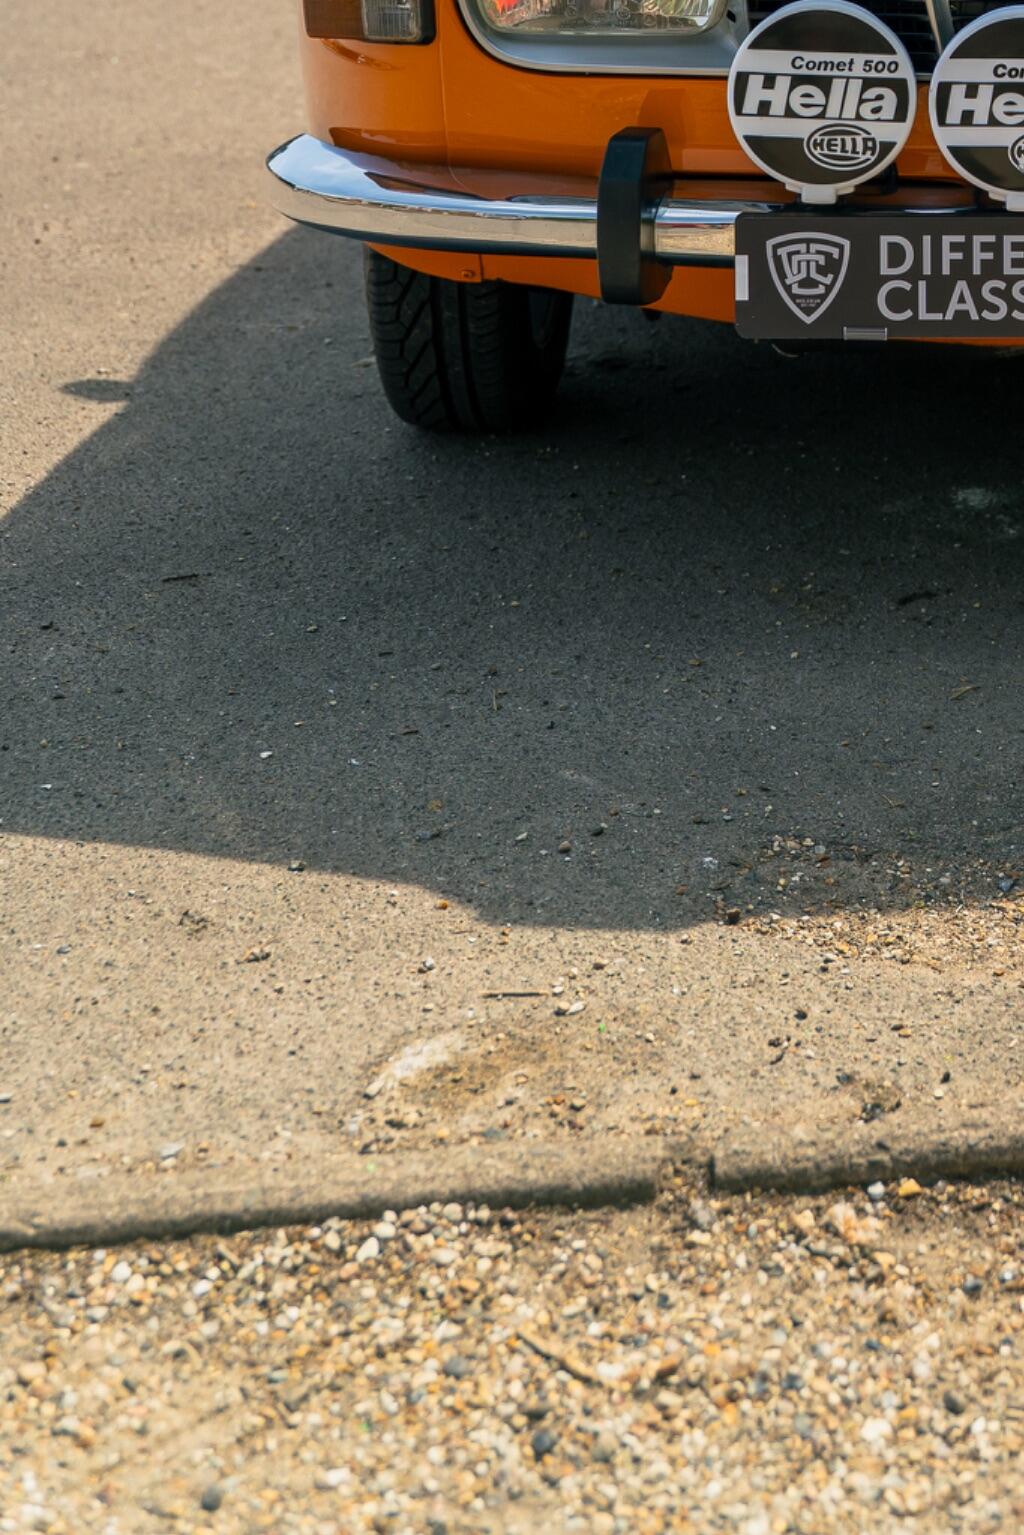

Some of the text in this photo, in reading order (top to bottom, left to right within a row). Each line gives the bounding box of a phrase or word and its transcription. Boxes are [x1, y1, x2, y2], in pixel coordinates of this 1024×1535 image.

[791, 56, 899, 73] Comet 500
[742, 74, 898, 121] Hella
[812, 137, 876, 156] HELLA
